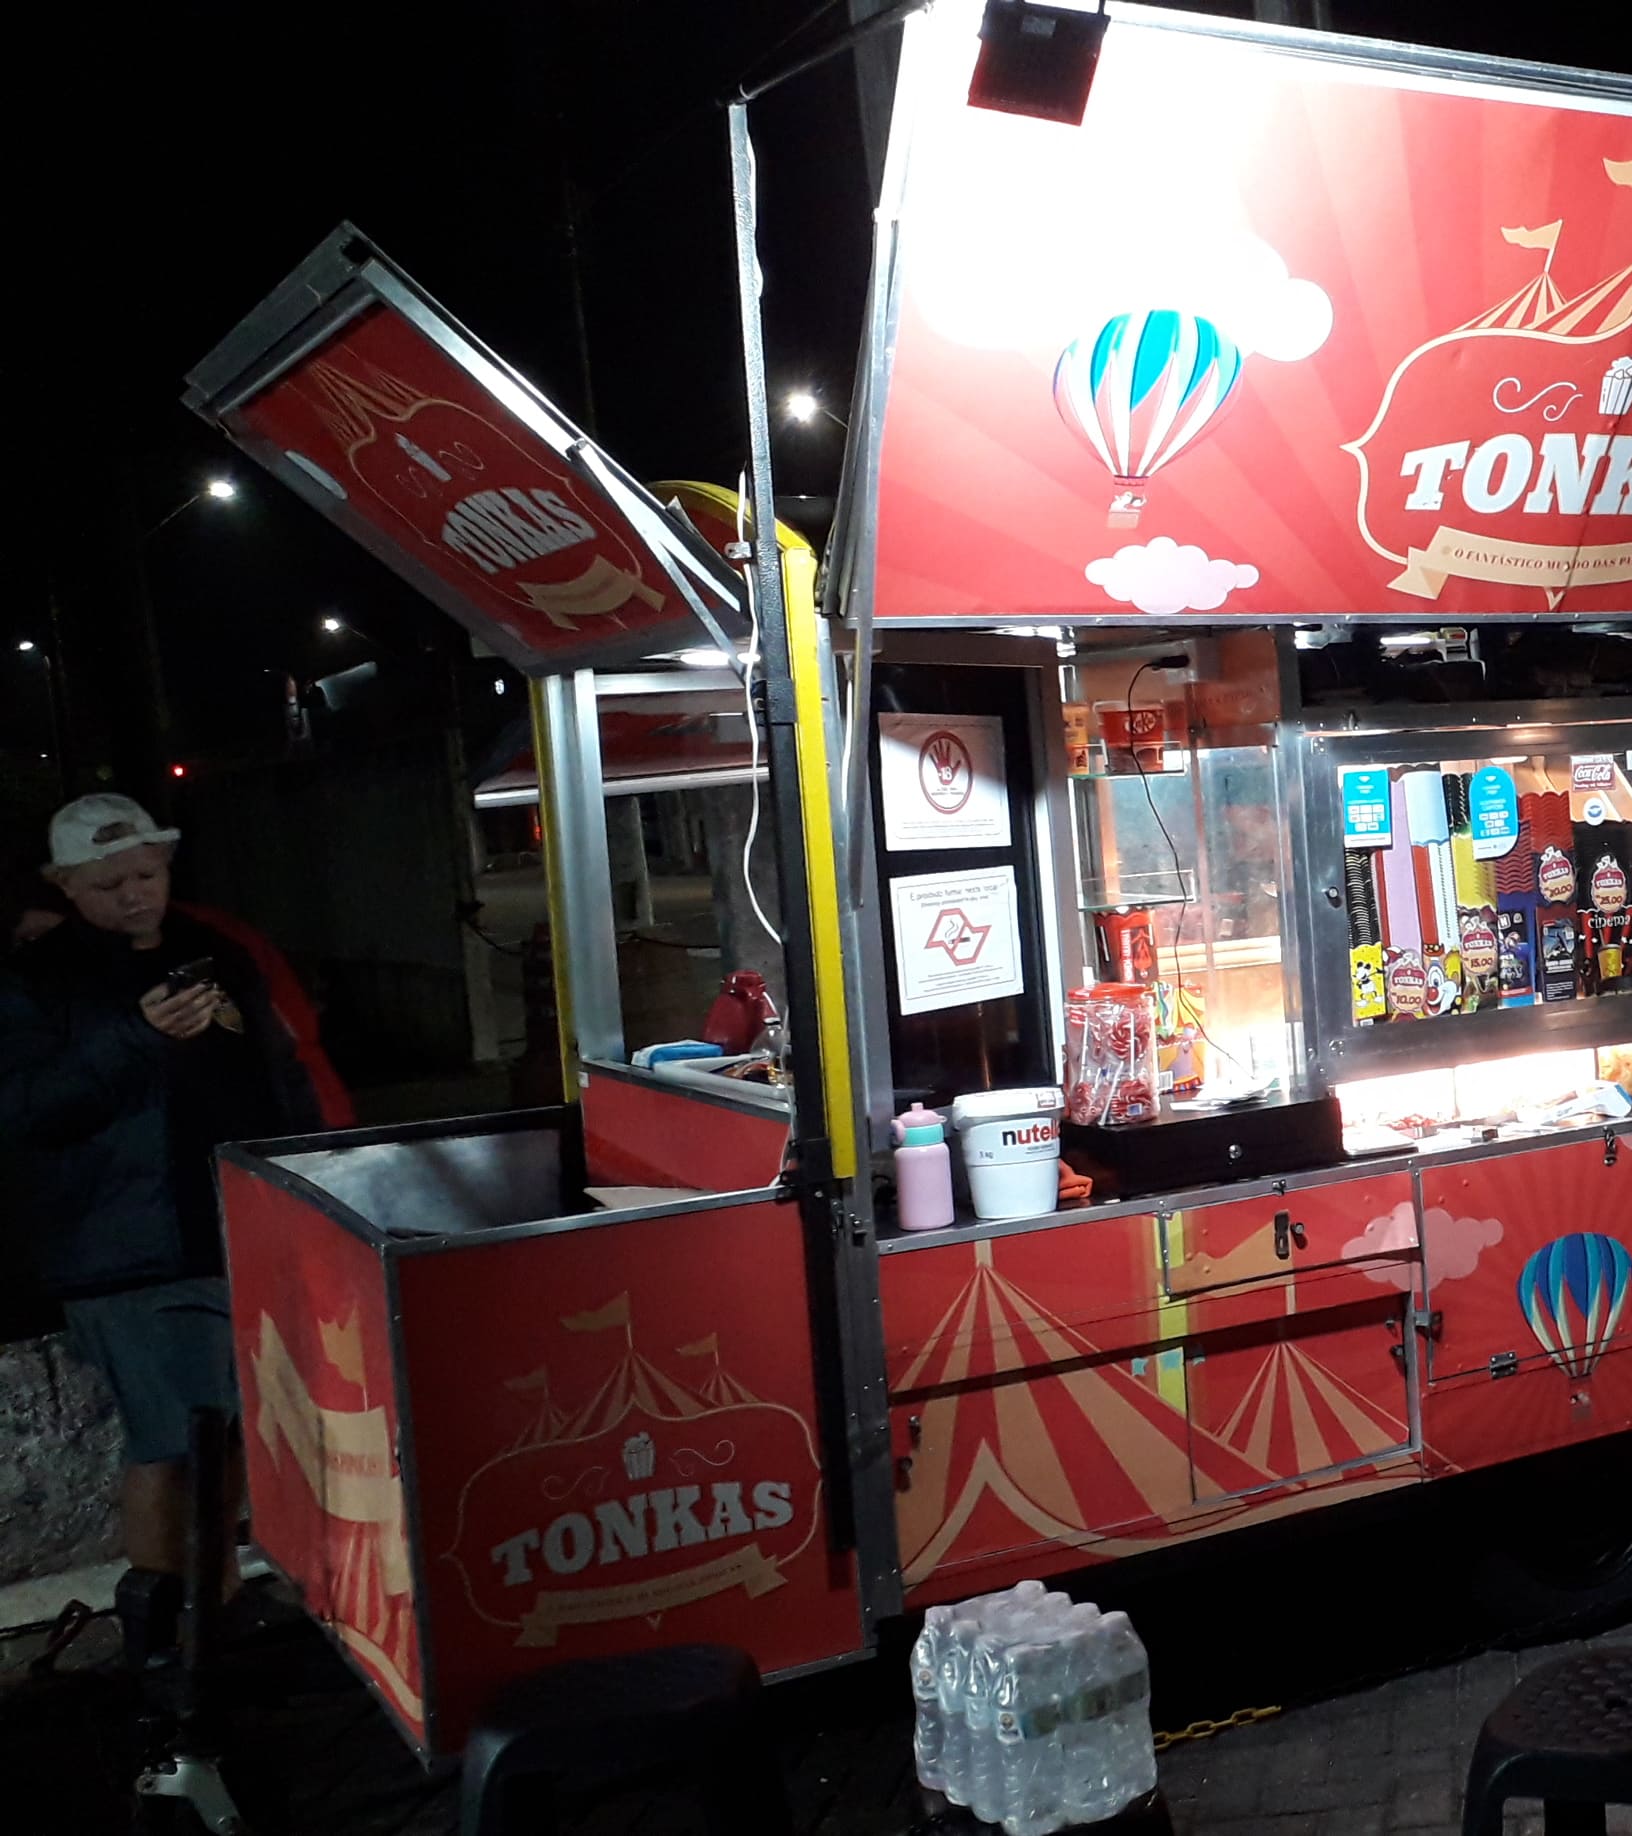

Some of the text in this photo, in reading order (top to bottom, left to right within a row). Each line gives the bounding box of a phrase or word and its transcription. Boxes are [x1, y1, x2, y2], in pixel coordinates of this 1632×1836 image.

[442, 486, 597, 575] TONKAS
[1001, 1119, 1060, 1146] nutell
[490, 1480, 794, 1588] TONKAS
